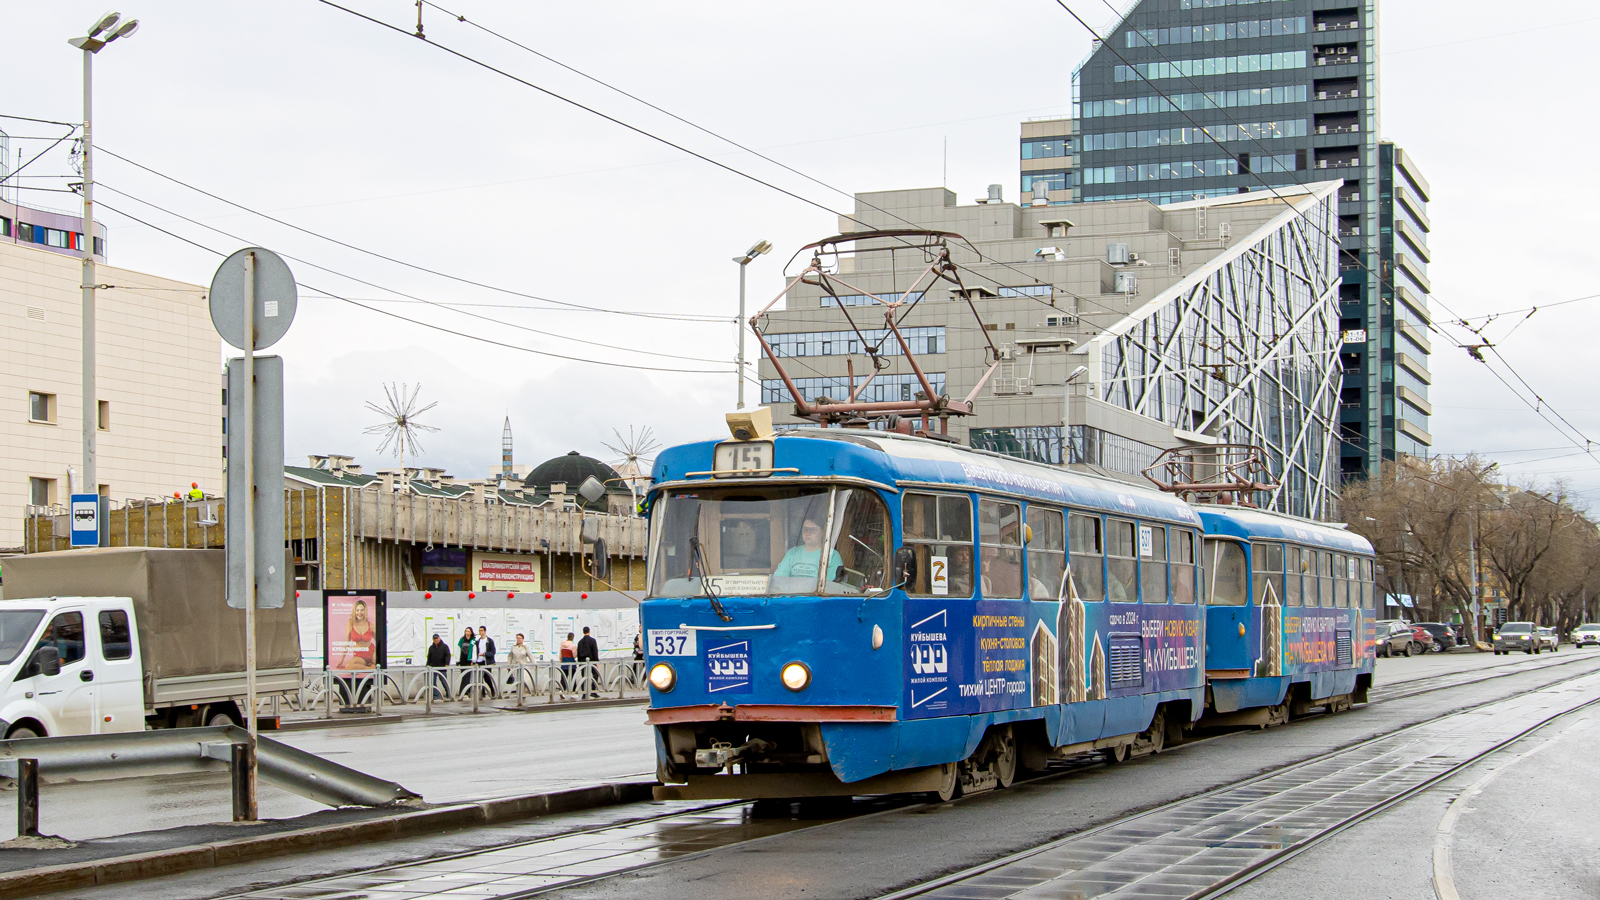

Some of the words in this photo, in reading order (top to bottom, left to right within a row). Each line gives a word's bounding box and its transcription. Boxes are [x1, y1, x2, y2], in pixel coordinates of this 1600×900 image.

[728, 447, 761, 476] 15
[1142, 530, 1150, 547] 537
[973, 616, 1007, 630] кирпичные
[1008, 616, 1025, 627] стены
[1126, 612, 1136, 624] 2024
[911, 631, 947, 642] КУЙБЫШЕВА
[1142, 620, 1163, 637] ВЫБЕРИ
[1165, 620, 1184, 637] НОВУЮ
[655, 636, 687, 654] 537
[981, 638, 1025, 653] кухня-столовая
[911, 644, 948, 674] 100
[983, 656, 1003, 672] тёплая
[1005, 659, 1025, 673] лоджия
[1154, 642, 1199, 671] КУЙБЫШЕВА
[708, 660, 748, 675] 100
[985, 678, 1005, 698] ЦЕНТР
[1007, 681, 1025, 696] города
